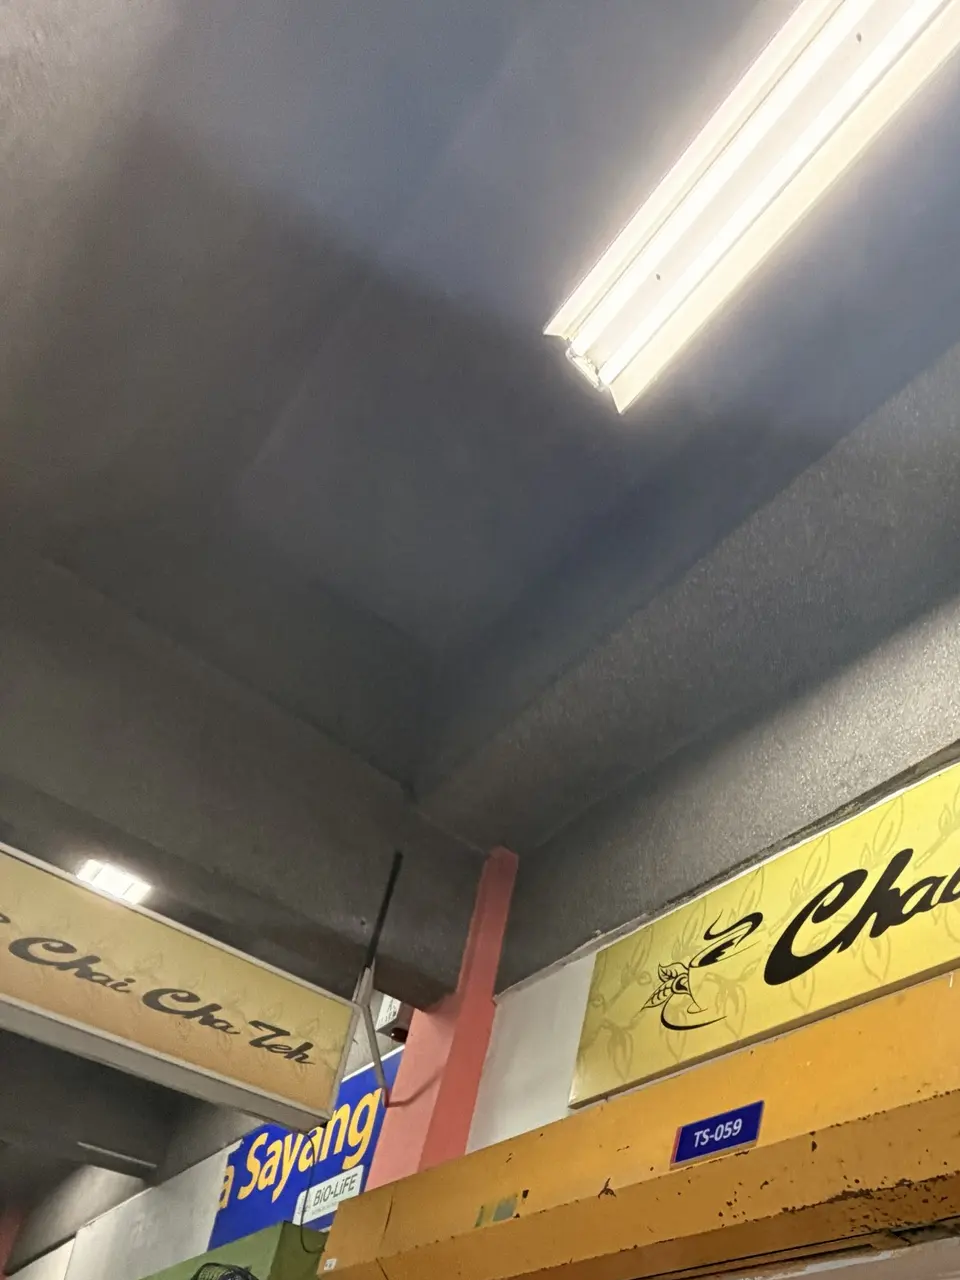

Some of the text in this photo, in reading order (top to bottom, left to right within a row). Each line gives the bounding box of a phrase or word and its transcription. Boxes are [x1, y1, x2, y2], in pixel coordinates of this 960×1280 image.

[8, 937, 315, 1065] Chai Cha Teh
[237, 1088, 382, 1203] Sayang
[694, 1118, 743, 1148] TS-059
